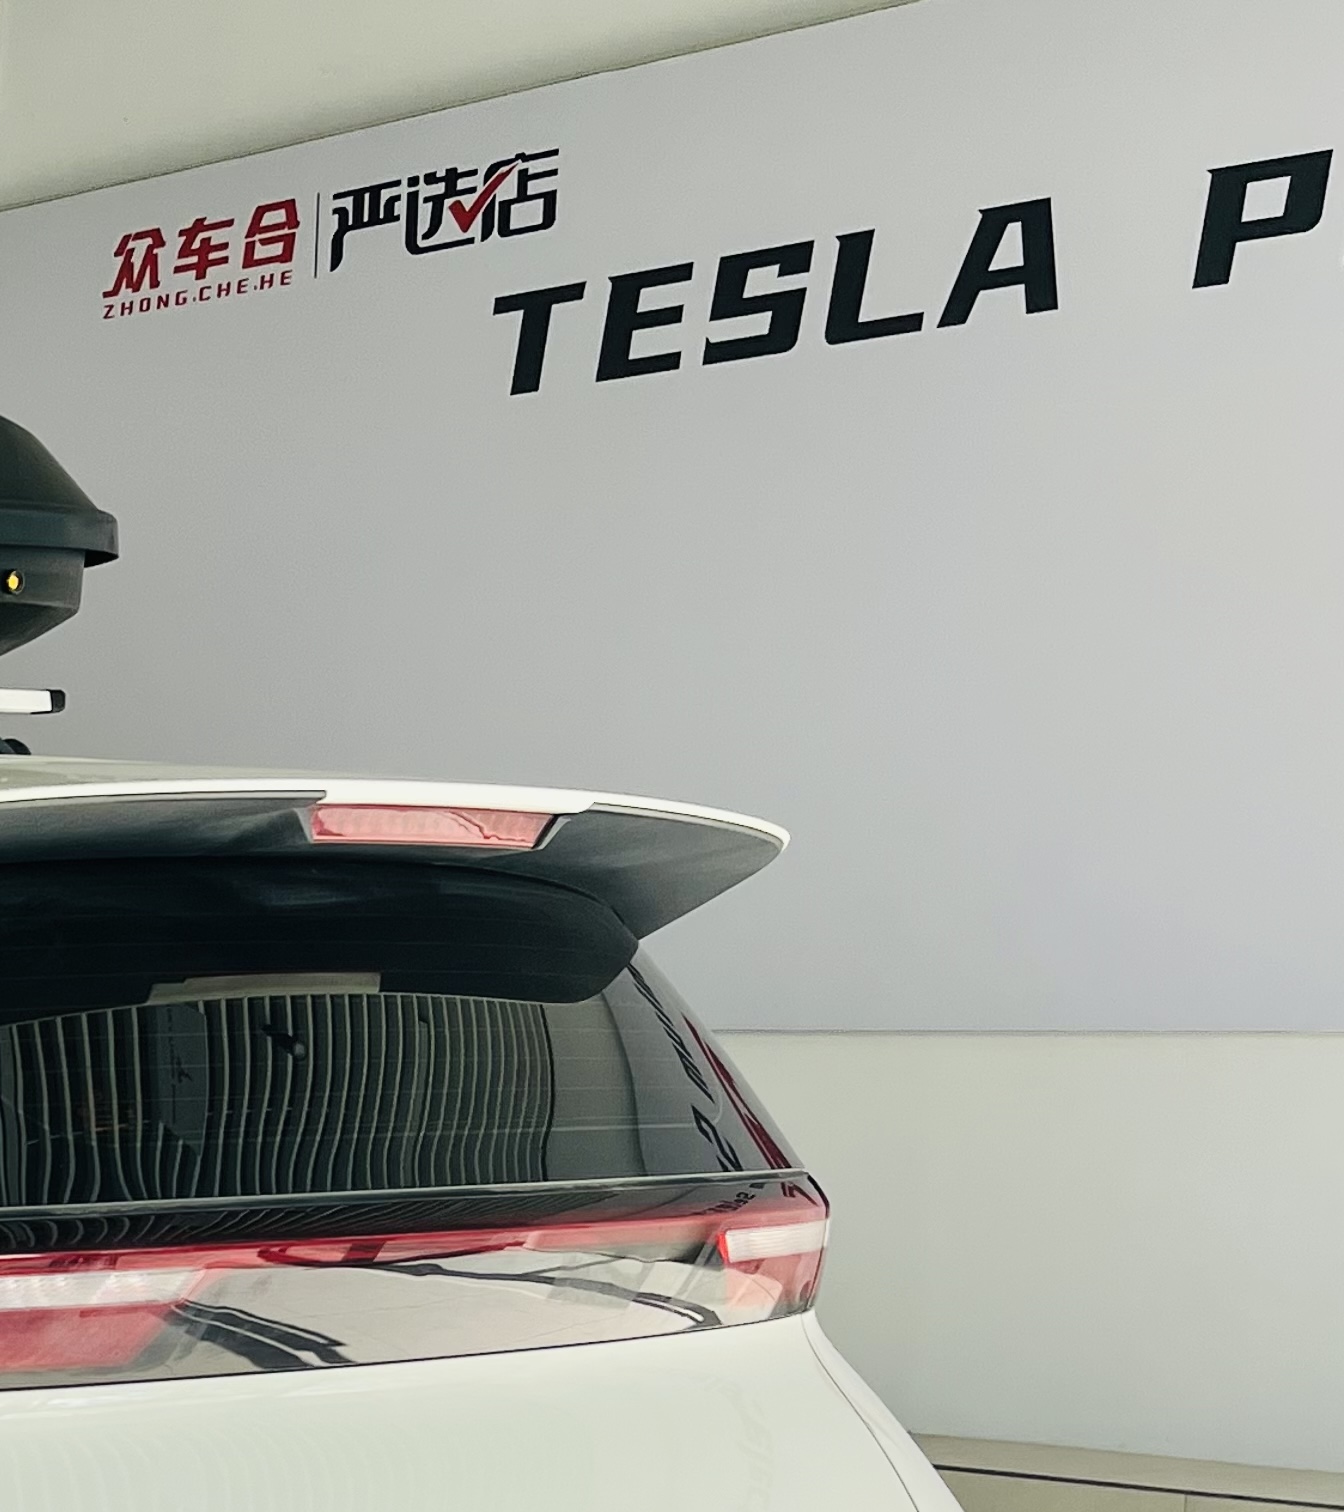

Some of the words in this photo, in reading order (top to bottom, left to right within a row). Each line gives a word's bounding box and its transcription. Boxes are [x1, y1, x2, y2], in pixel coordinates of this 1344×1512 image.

[102, 198, 301, 298] 众车合
[329, 148, 560, 272] 严选店
[493, 197, 1059, 396] TESLA
